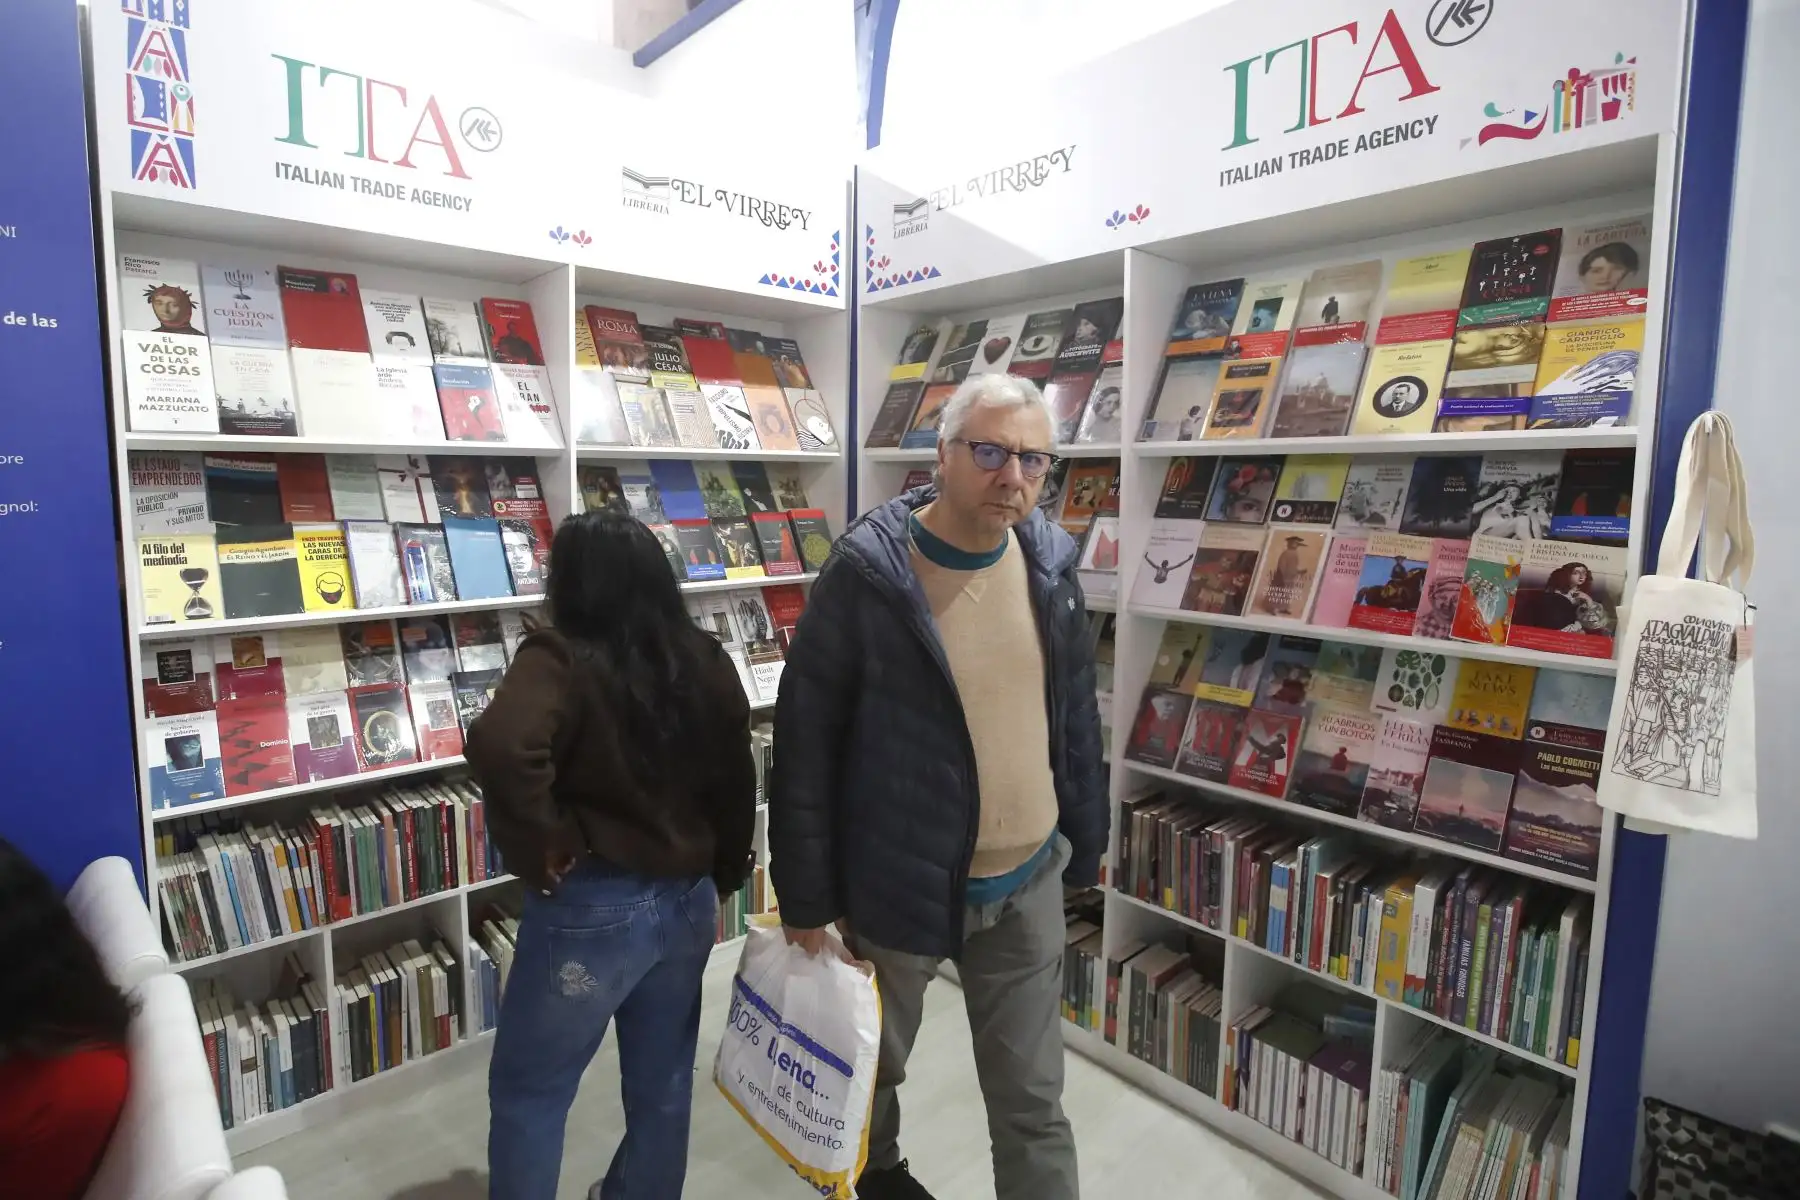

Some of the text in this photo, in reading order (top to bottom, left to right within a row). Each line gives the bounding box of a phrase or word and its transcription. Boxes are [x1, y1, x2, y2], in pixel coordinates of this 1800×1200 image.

[1222, 9, 1441, 151] ITA
[271, 53, 473, 180] ITA
[1220, 115, 1439, 187] ITALIAN TRADE AGENCY
[930, 145, 1077, 212] EL VIRREY
[275, 161, 473, 213] ITALIAN TRADE AGENCY
[622, 197, 671, 216] LIBRERIA
[671, 178, 813, 231] EL VIRREY
[893, 222, 929, 239] LIBRERIA
[124, 257, 161, 266] Francisco
[125, 266, 158, 275] Petrarca
[234, 302, 249, 310] LA
[4, 311, 58, 328] de las
[213, 308, 275, 320] CUESTIÓN
[597, 319, 638, 335] ROMA
[1566, 327, 1620, 338] GIANRICO
[162, 336, 174, 344] EL
[1559, 333, 1626, 344] CAROFIGLIO
[137, 342, 199, 357] VALOR
[150, 355, 190, 364] DE LAS
[140, 363, 200, 377] COSAS
[654, 361, 687, 373] CÉSAR
[146, 395, 201, 405] MARIANA
[138, 403, 209, 413] MAZZUCATO
[130, 456, 181, 472] EL ESTADO
[132, 471, 202, 486] EMPRENDEDOR
[136, 491, 179, 506] LA OPOSICIÓN
[178, 505, 205, 516] PRIVADO
[171, 516, 184, 526] SUS
[185, 512, 205, 524] MITOS
[142, 541, 186, 555] Al filo del
[307, 547, 332, 555] CARAS
[142, 554, 188, 567] mediodía
[315, 553, 350, 561] DERECHA
[1468, 679, 1518, 696] NEWS
[1334, 718, 1375, 733] ABRIGOS
[260, 738, 289, 748] Dominio
[1434, 737, 1472, 750] TASMANIA
[1561, 756, 1601, 771] COGNETTI
[737, 1070, 845, 1151] y entretenimiento.
[777, 1083, 846, 1131] de cultura
